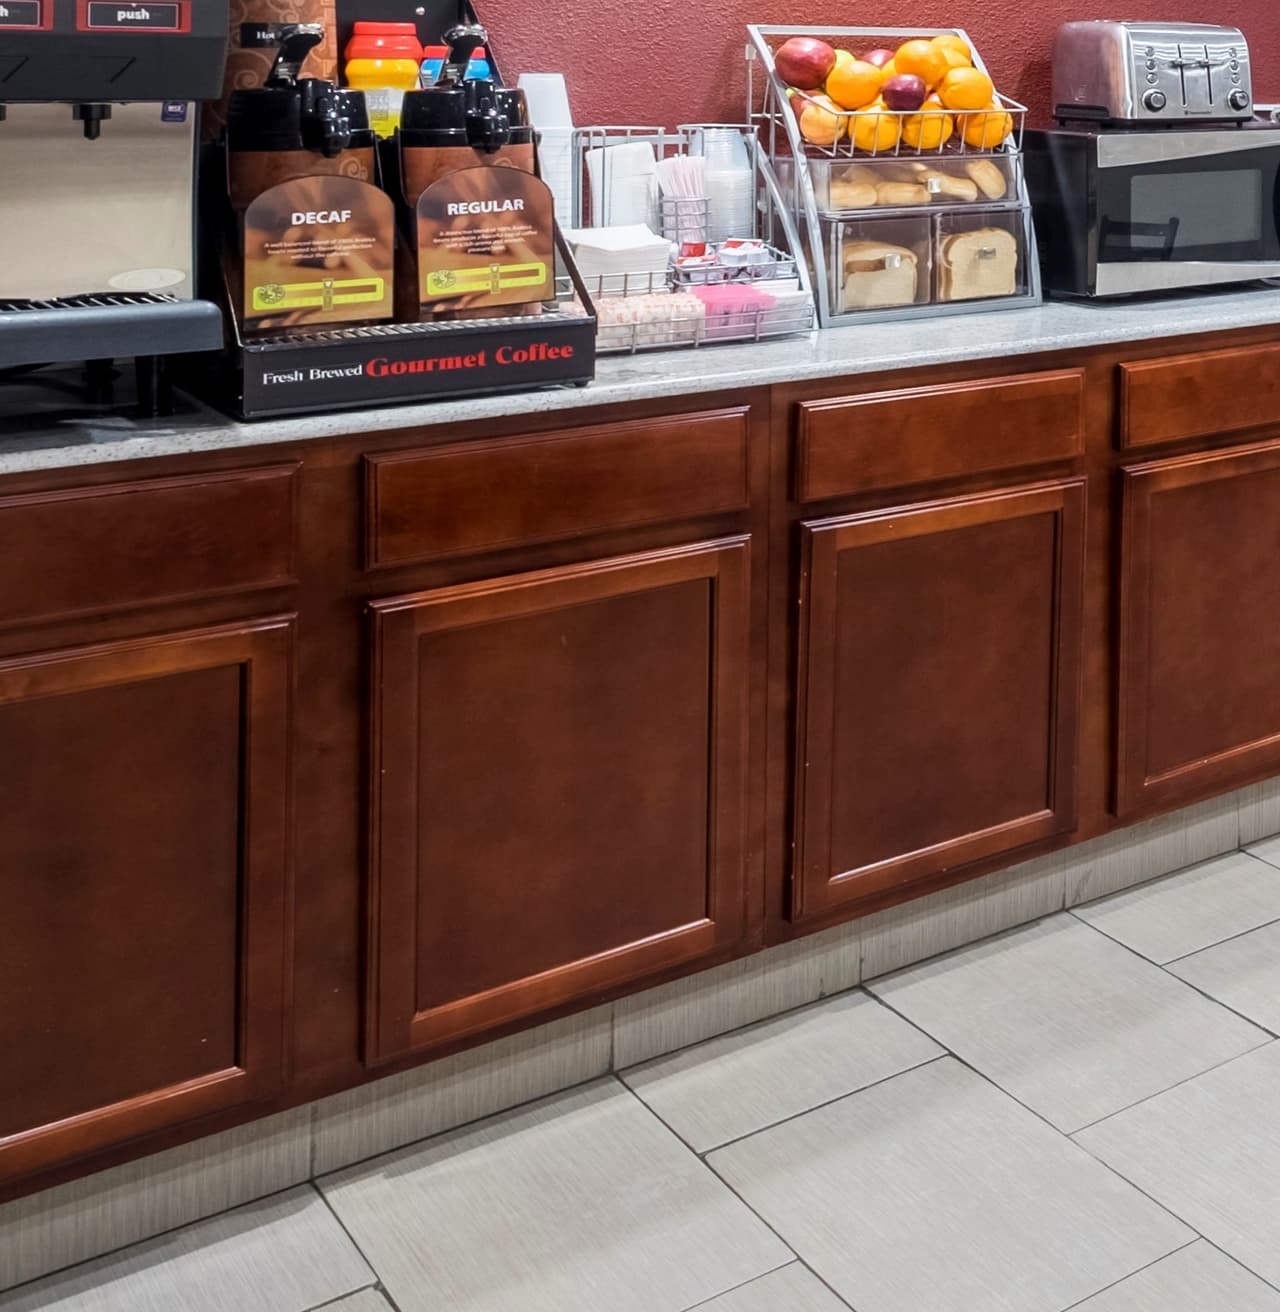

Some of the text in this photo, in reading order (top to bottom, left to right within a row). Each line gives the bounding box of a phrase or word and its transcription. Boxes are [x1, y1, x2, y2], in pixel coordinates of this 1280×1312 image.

[117, 8, 150, 21] push
[447, 198, 524, 216] REGULAR
[291, 210, 351, 225] DECAF
[263, 342, 574, 385] Fresh Brewed Gourmet Coffee
